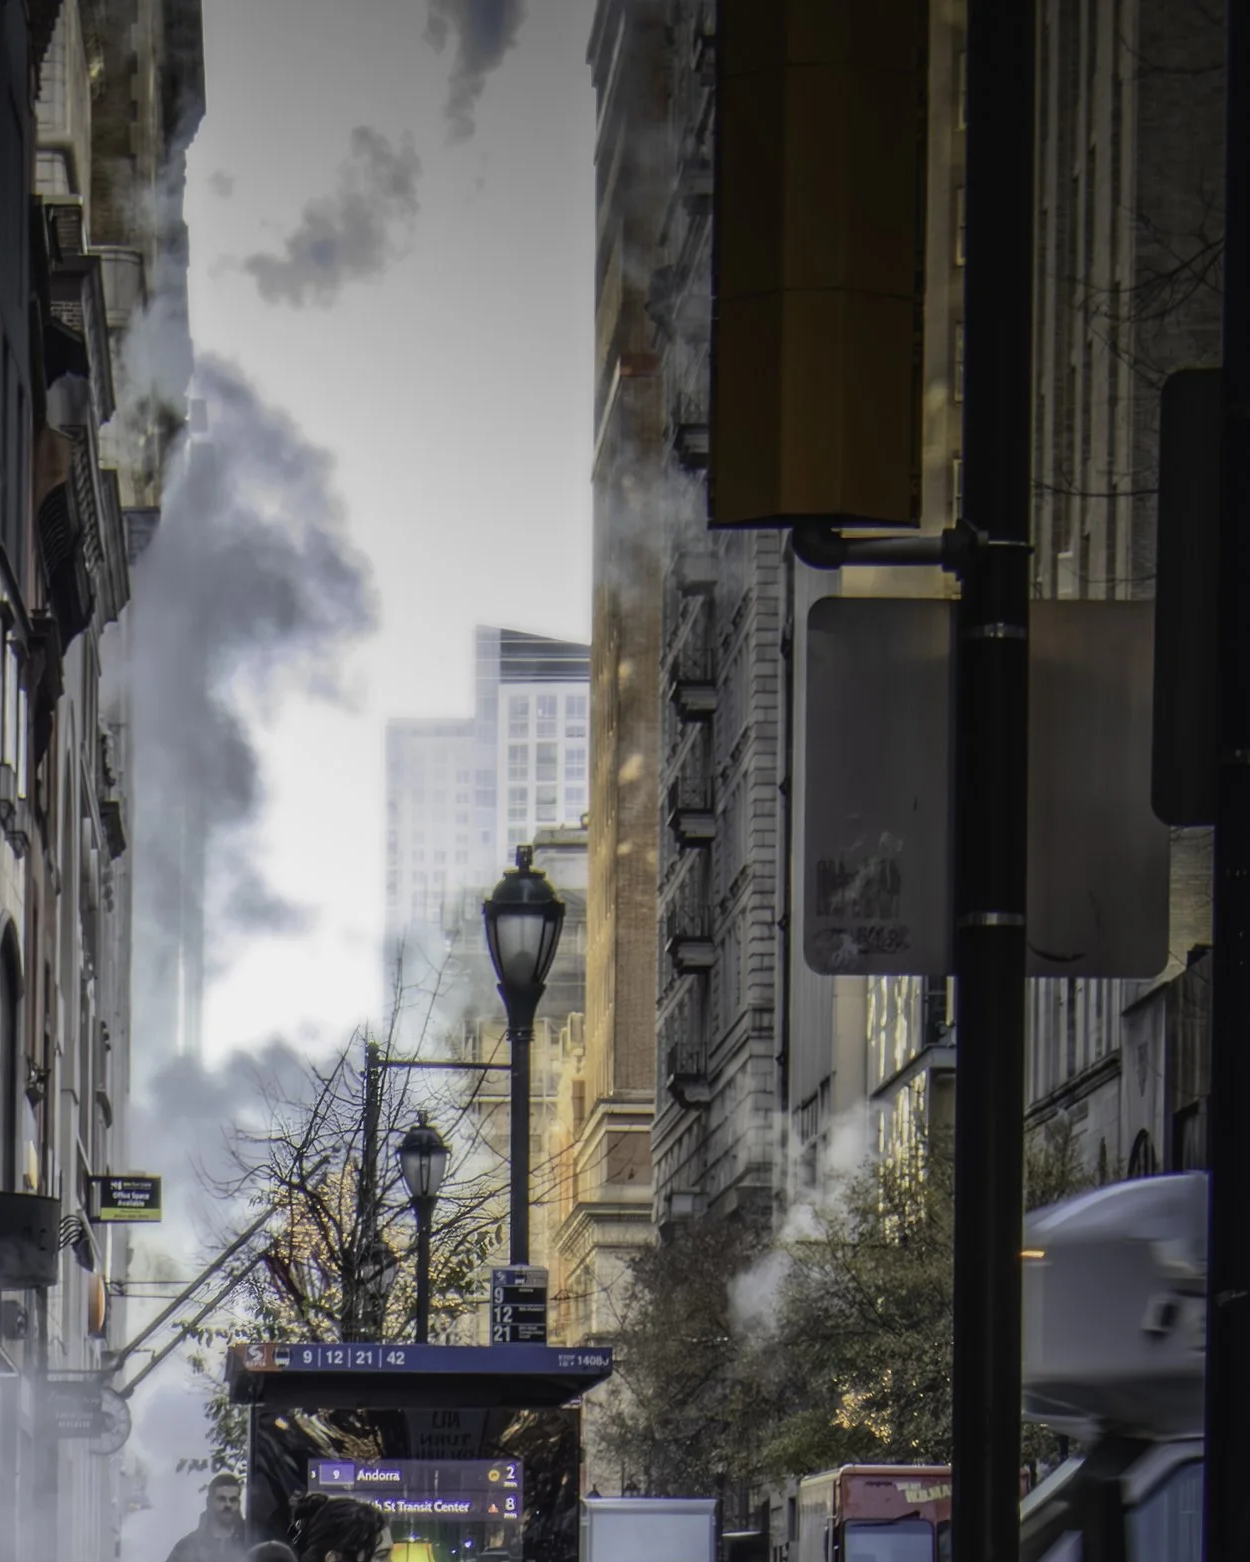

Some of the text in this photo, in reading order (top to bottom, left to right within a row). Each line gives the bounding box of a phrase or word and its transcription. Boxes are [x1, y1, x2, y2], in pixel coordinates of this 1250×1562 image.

[494, 1287, 504, 1304] 9
[493, 1306, 513, 1323] 12
[493, 1325, 511, 1342] 21
[302, 1351, 406, 1365] 9 12 21 42
[333, 1469, 340, 1480] 9
[357, 1469, 400, 1481] Andorra
[505, 1466, 515, 1479] 2
[383, 1500, 396, 1512] St
[396, 1500, 432, 1512] Transit
[434, 1500, 470, 1513] Center
[505, 1497, 515, 1510] 8
